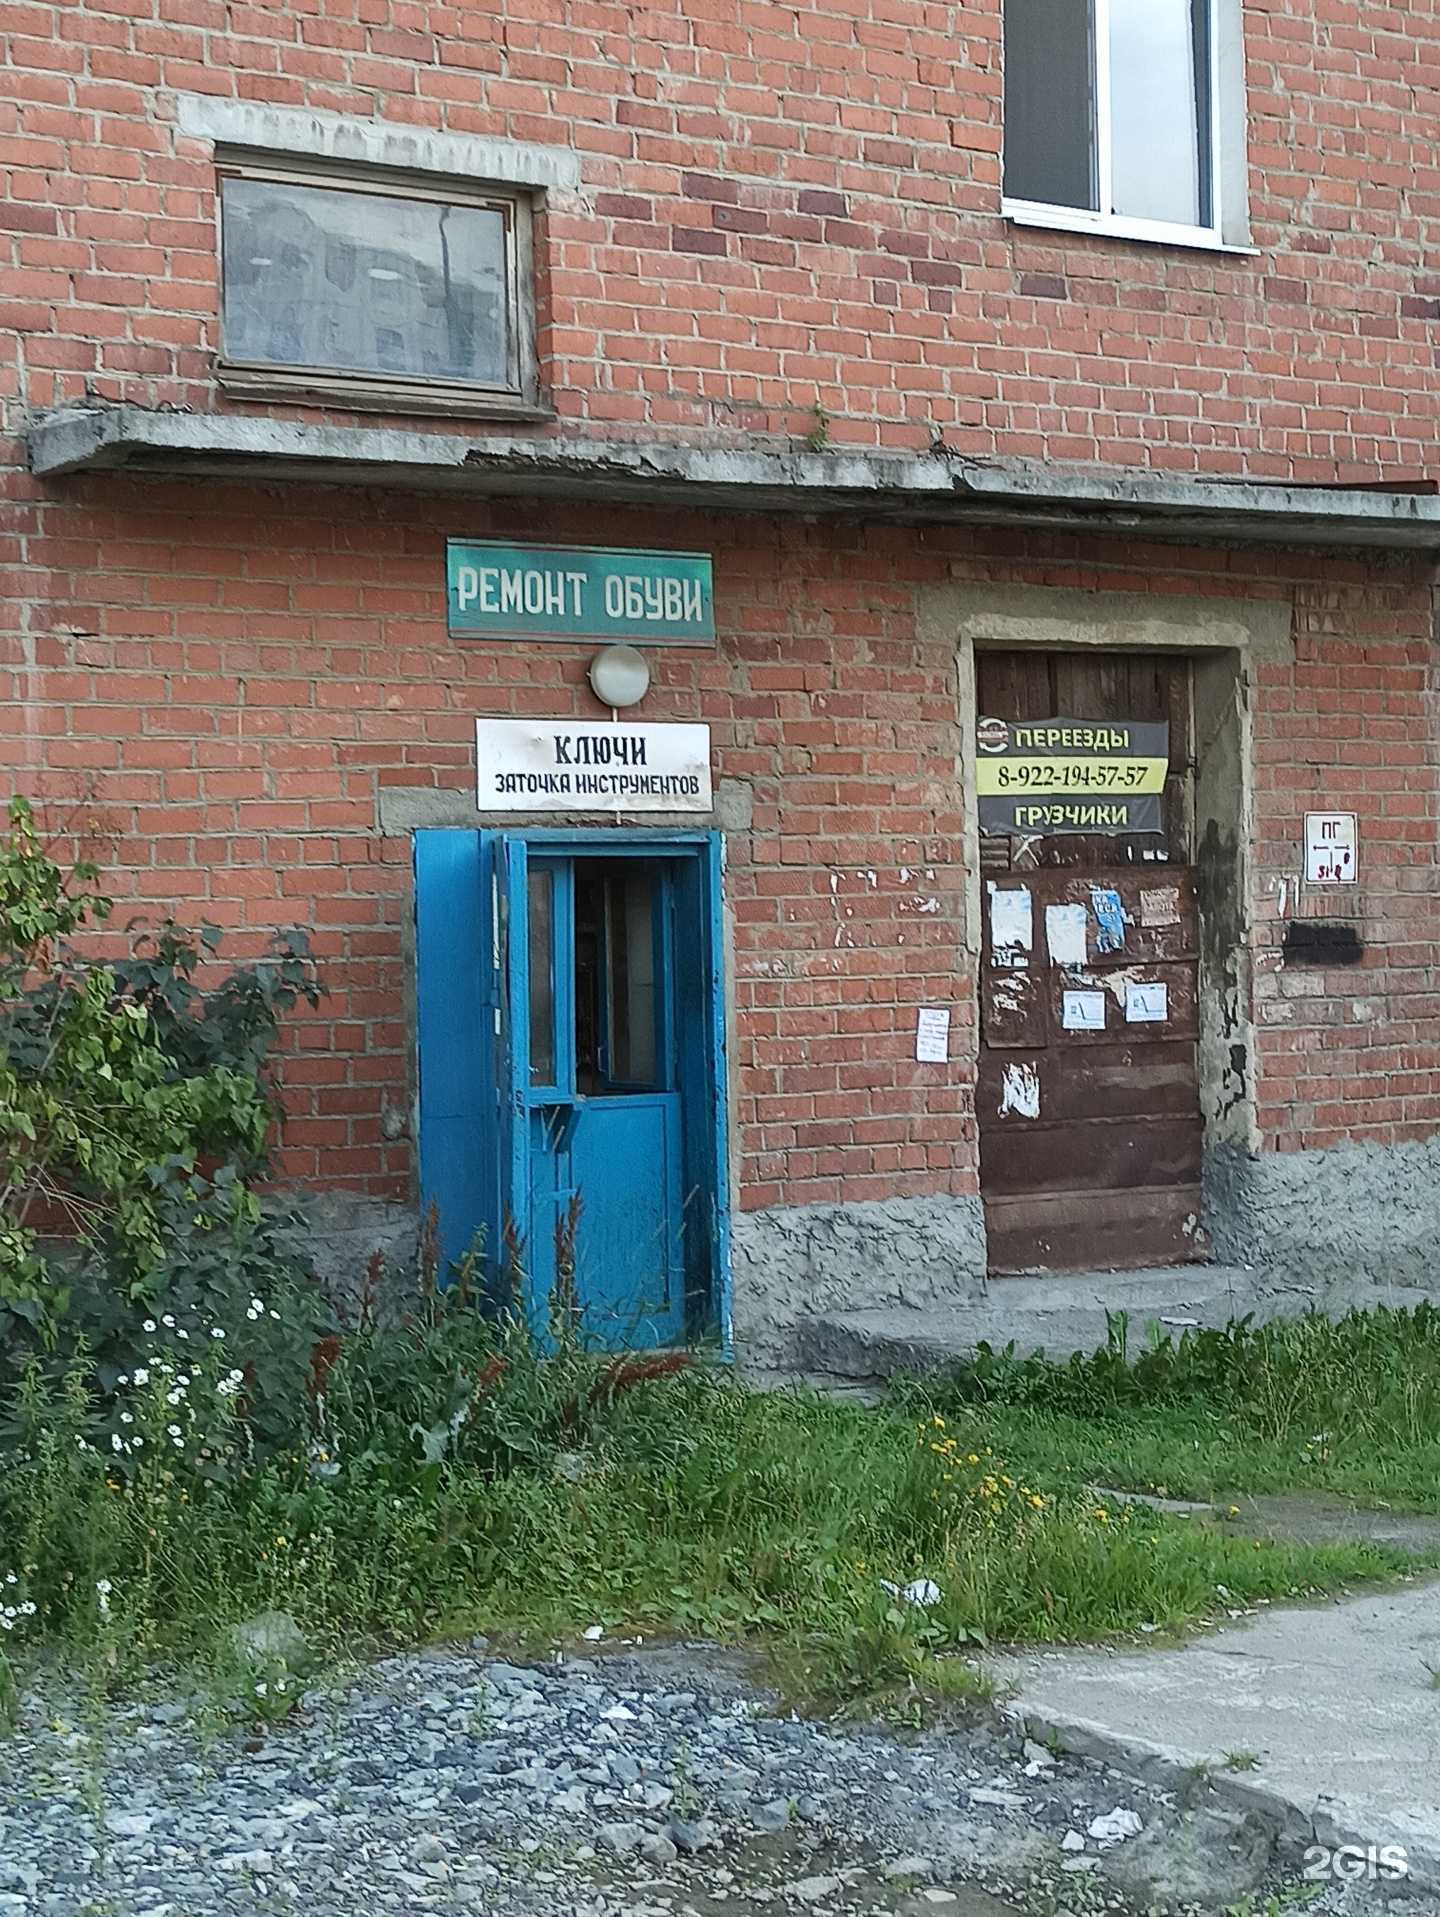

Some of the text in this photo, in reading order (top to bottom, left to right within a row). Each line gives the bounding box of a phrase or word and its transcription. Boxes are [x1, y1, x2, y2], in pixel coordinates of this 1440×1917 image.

[456, 566, 703, 623] РЕМОНТ ОБУВИ
[554, 735, 647, 766] КЛЮЧИ
[1016, 727, 1129, 752] ПЕРЕЕЗДЫ
[495, 773, 700, 795] ЗАТОЧКА ИНСТРУМЕНТОВ
[998, 765, 1149, 788] 8-922-194-57-57
[1015, 805, 1128, 827] ГРУЗЧИКИ
[1322, 821, 1341, 839] ПГ
